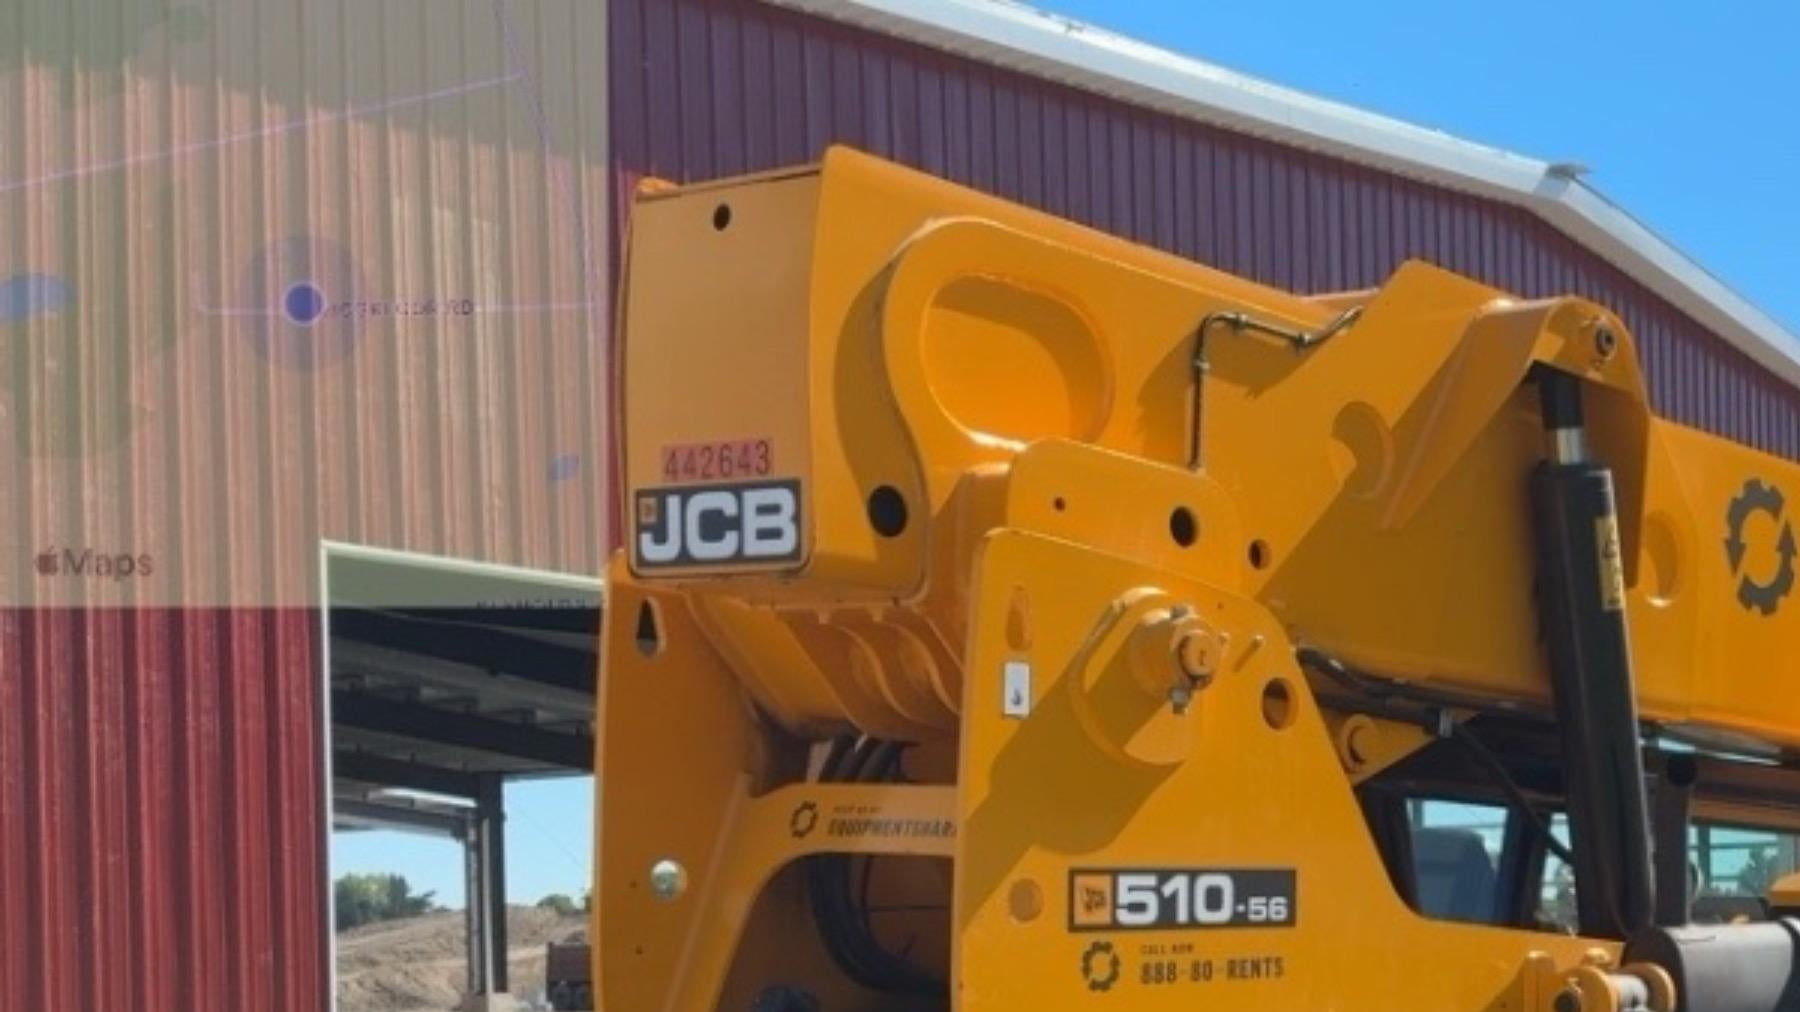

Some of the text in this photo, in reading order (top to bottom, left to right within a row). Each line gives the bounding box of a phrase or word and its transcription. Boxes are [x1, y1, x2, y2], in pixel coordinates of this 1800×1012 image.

[664, 440, 771, 481] 442643
[640, 487, 797, 563] JCB
[1116, 872, 1289, 927] 510-56
